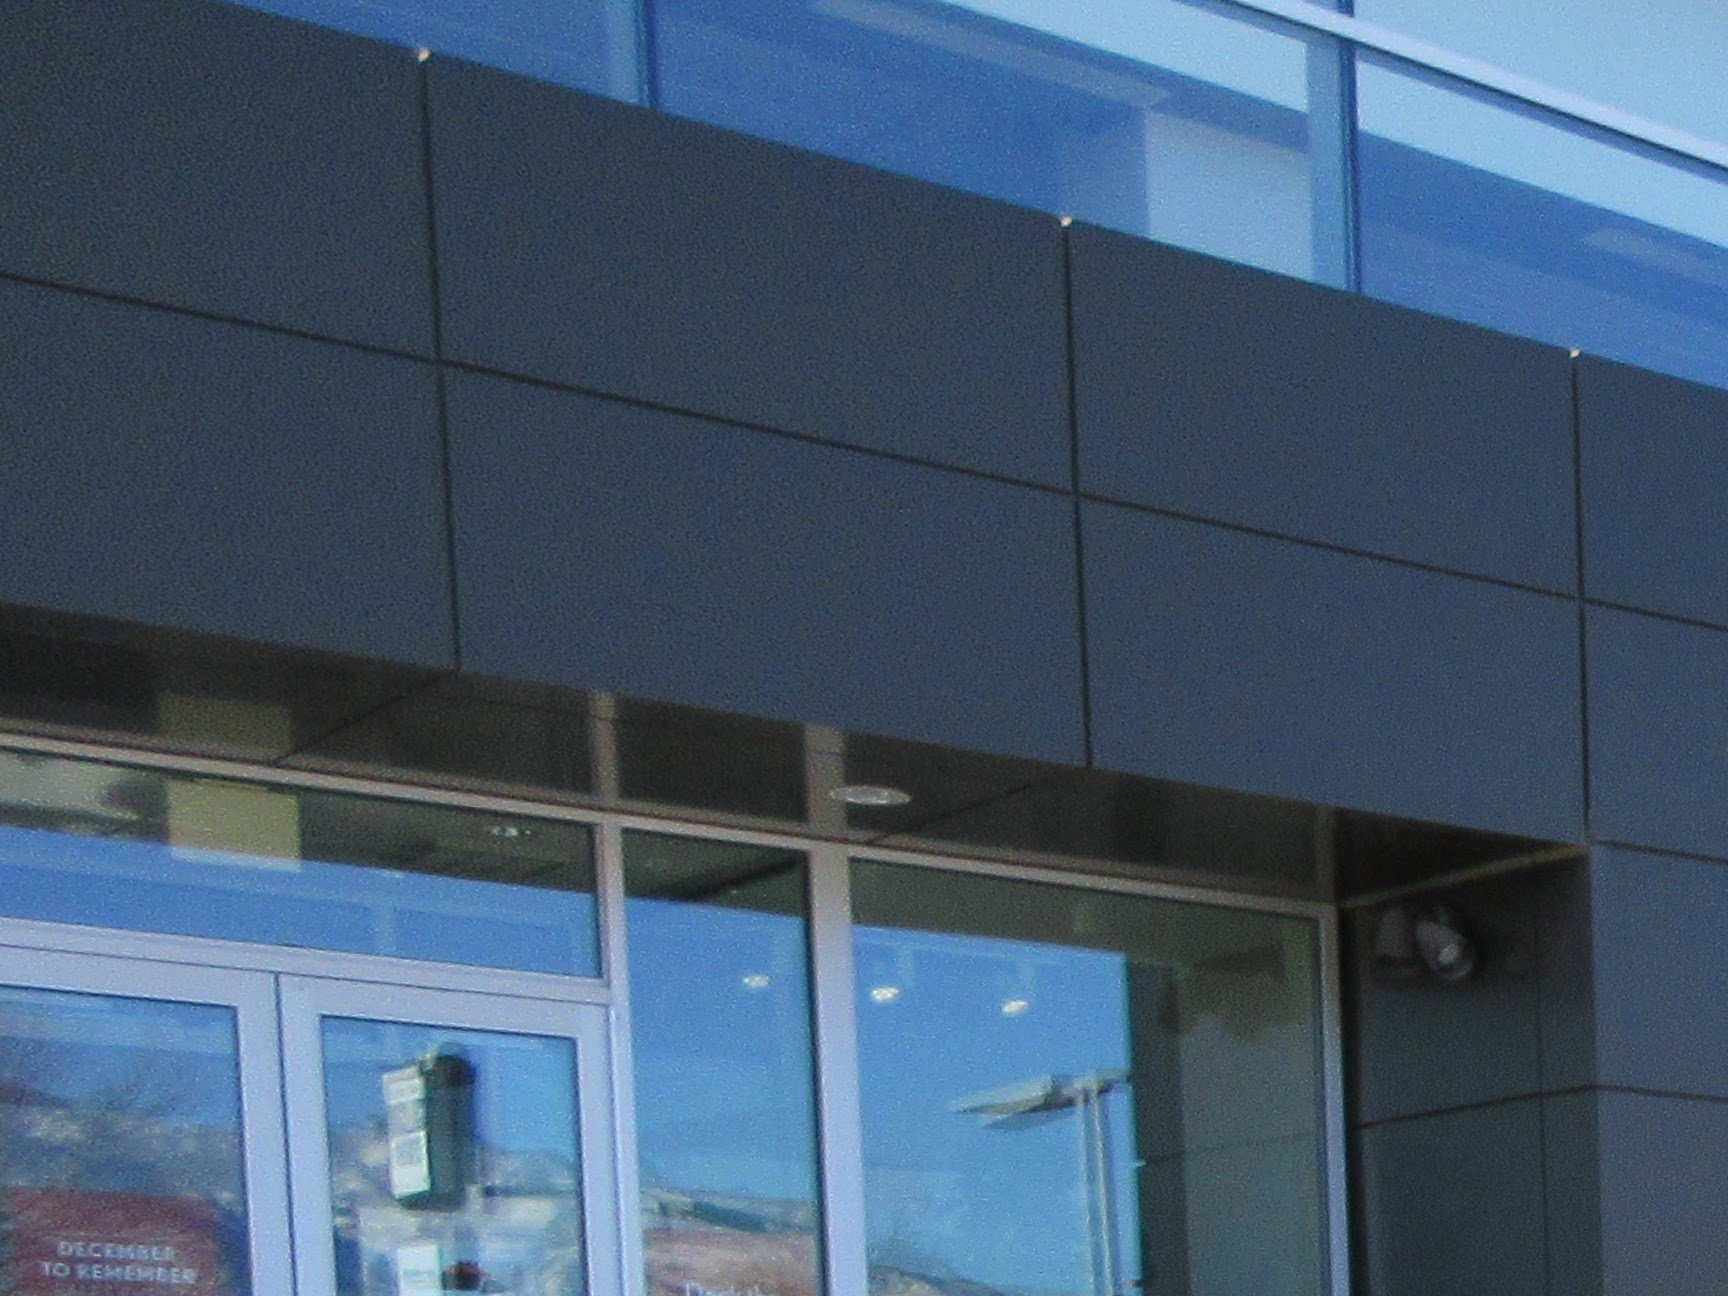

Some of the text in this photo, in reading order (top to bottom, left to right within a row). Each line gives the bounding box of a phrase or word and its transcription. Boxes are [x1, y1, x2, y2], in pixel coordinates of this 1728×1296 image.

[56, 1240, 176, 1262] DECEMBER
[40, 1260, 200, 1285] TO REMEMBER
